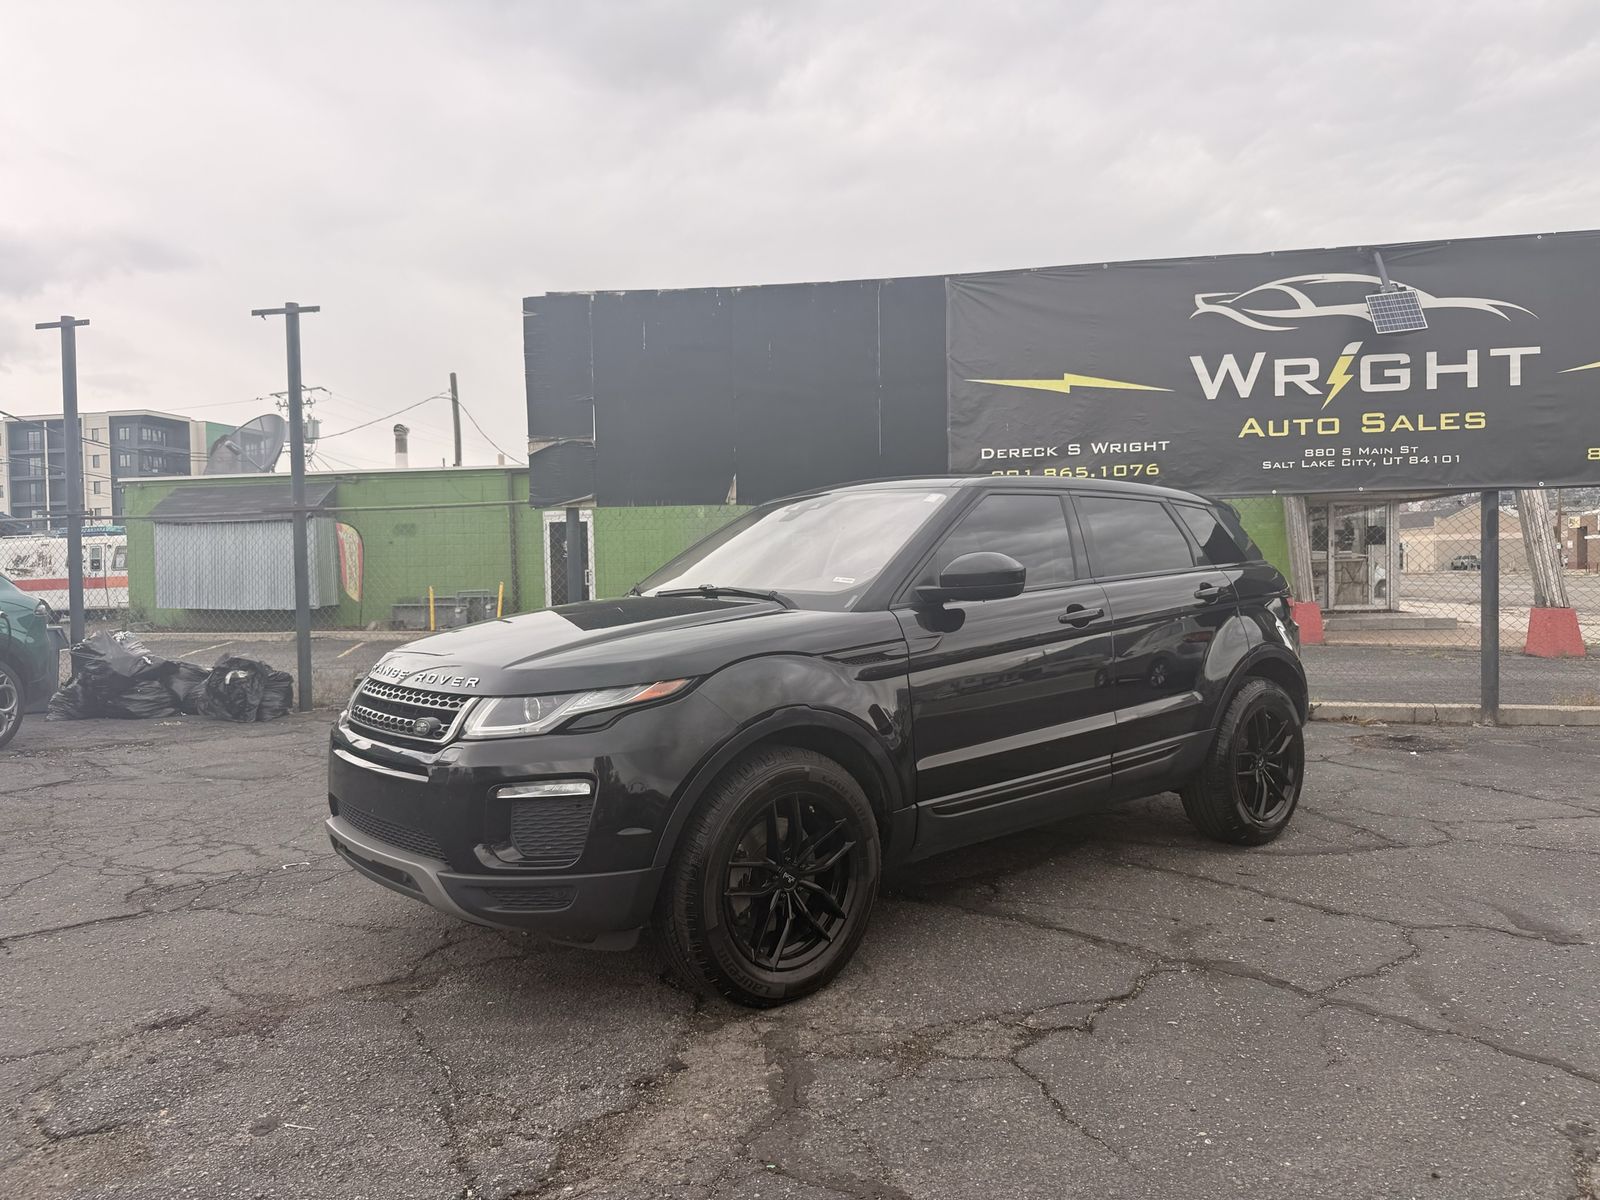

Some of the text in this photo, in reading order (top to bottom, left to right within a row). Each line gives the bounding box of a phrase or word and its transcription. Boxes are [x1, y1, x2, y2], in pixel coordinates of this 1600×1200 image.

[1190, 341, 1541, 410] WRIGHT
[1238, 412, 1486, 438] AUTO SALES
[981, 440, 1170, 460] DERECK S WRIGHT
[1304, 445, 1419, 458] 880 S MAIN ST
[1262, 454, 1461, 470] SALT LAKE CITY, UT 84101
[414, 673, 480, 688] ROVER
